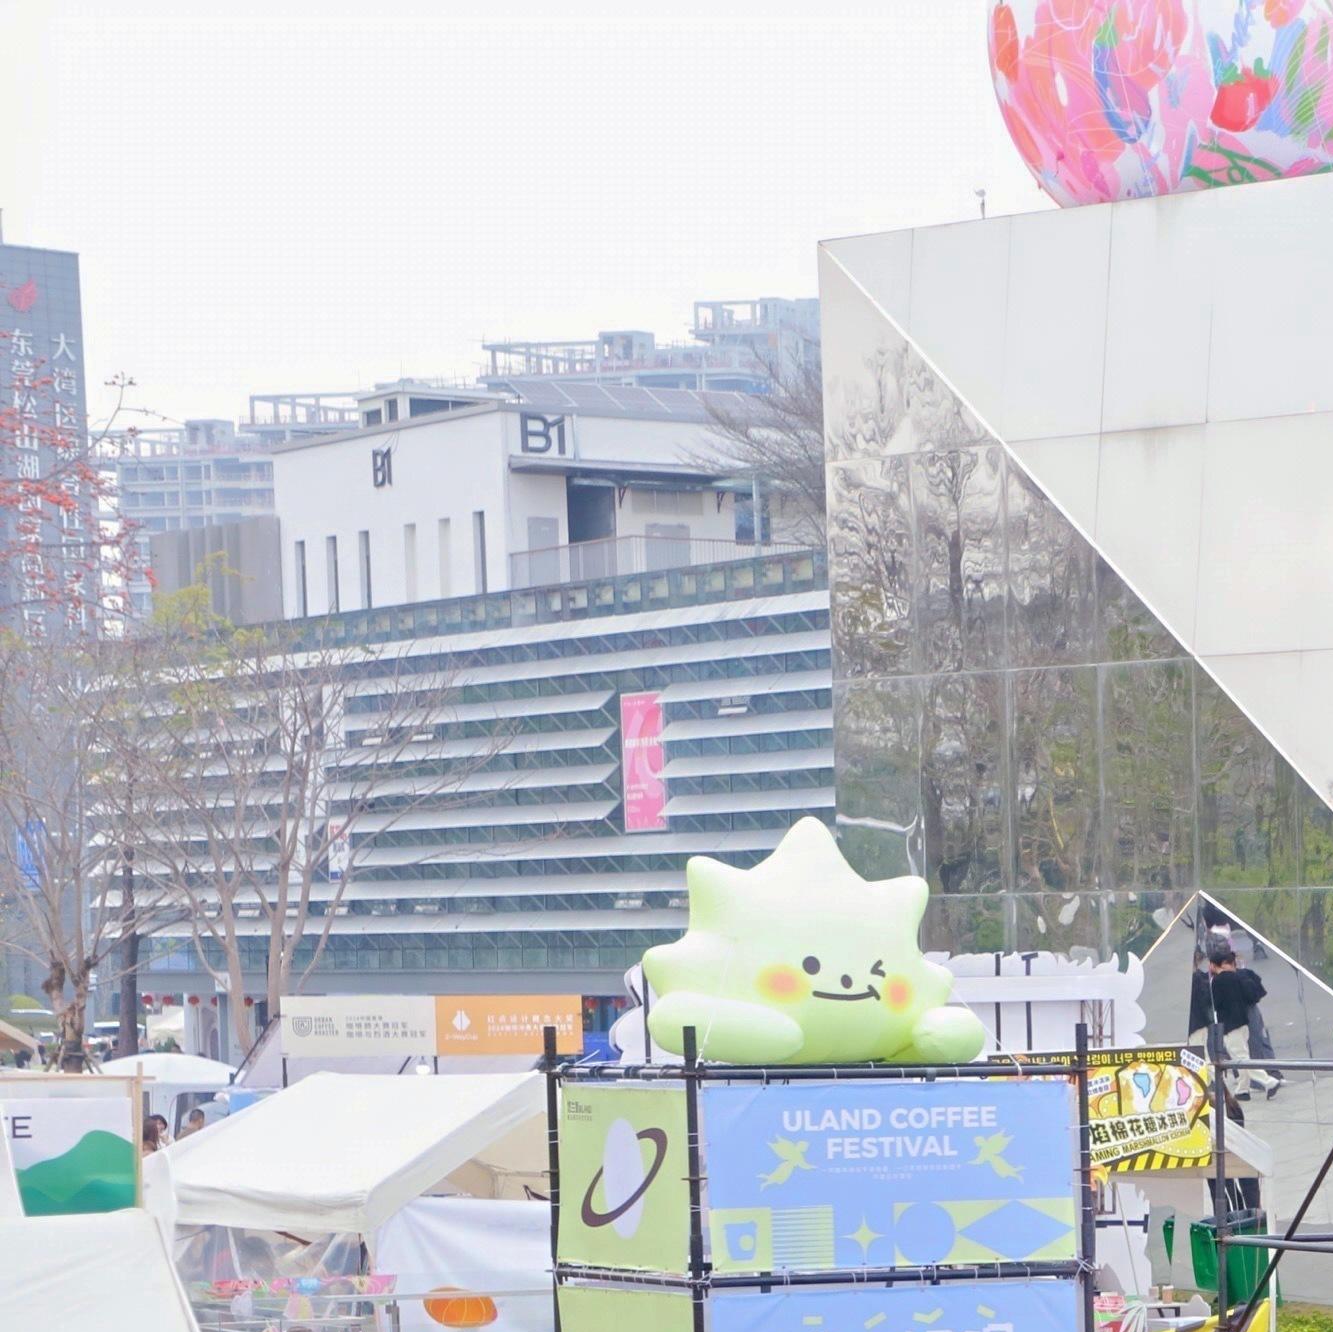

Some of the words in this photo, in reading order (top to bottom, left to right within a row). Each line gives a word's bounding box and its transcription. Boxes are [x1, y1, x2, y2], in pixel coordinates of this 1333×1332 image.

[519, 412, 567, 455] B1
[372, 446, 393, 488] B1
[782, 1108, 882, 1132] ULAND
[889, 1106, 998, 1129] COFFEE
[1090, 1110, 1189, 1145] 焰棉花糖冰淇淋
[826, 1135, 958, 1160] FESTIVAL
